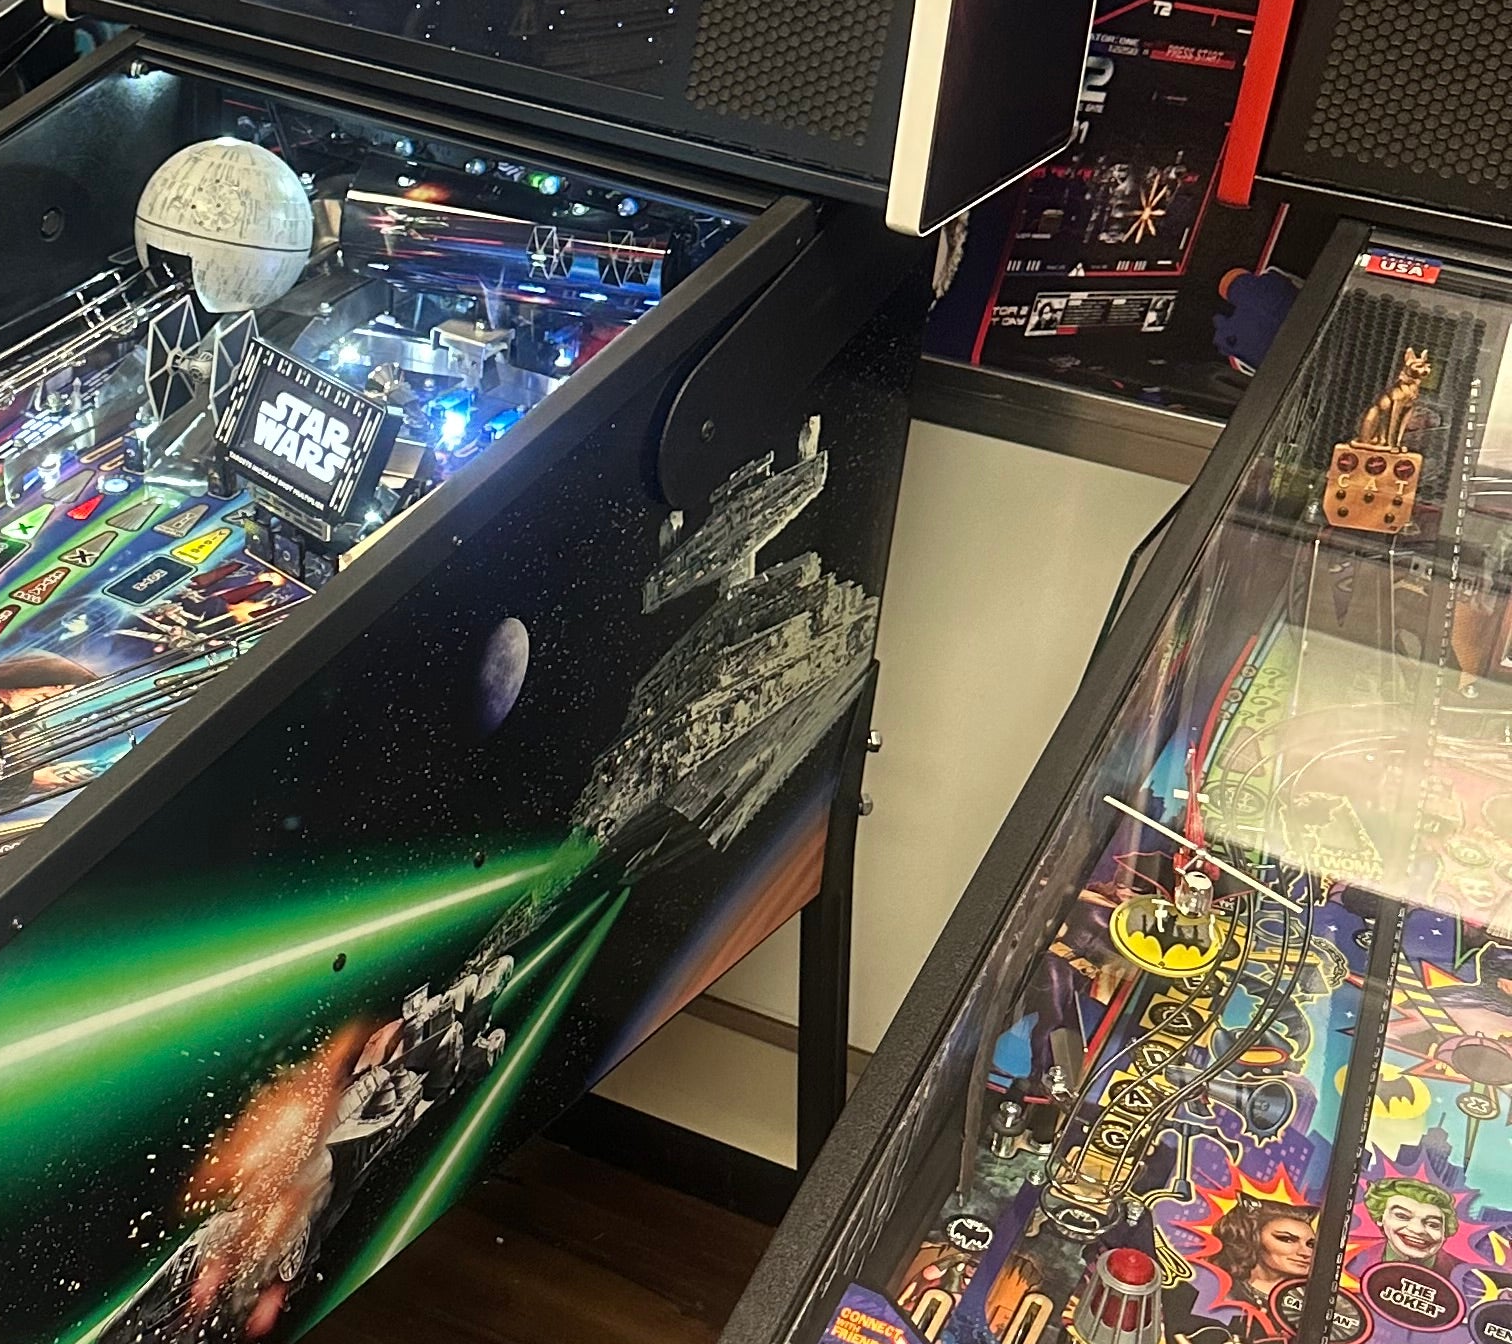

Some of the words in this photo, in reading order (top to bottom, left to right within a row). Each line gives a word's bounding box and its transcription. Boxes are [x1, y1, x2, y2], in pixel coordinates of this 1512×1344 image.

[1153, 0, 1173, 16] T2
[1168, 44, 1194, 59] PRESS
[1195, 47, 1224, 63] START
[1380, 259, 1424, 278] USA
[259, 391, 351, 458] STAR
[254, 412, 347, 483] WARS
[227, 450, 252, 468] TARGETS
[1401, 1279, 1435, 1299] THE
[1380, 1287, 1437, 1317] JOKER
[836, 1318, 863, 1334] WITH
[840, 1307, 904, 1341] CONNECT
